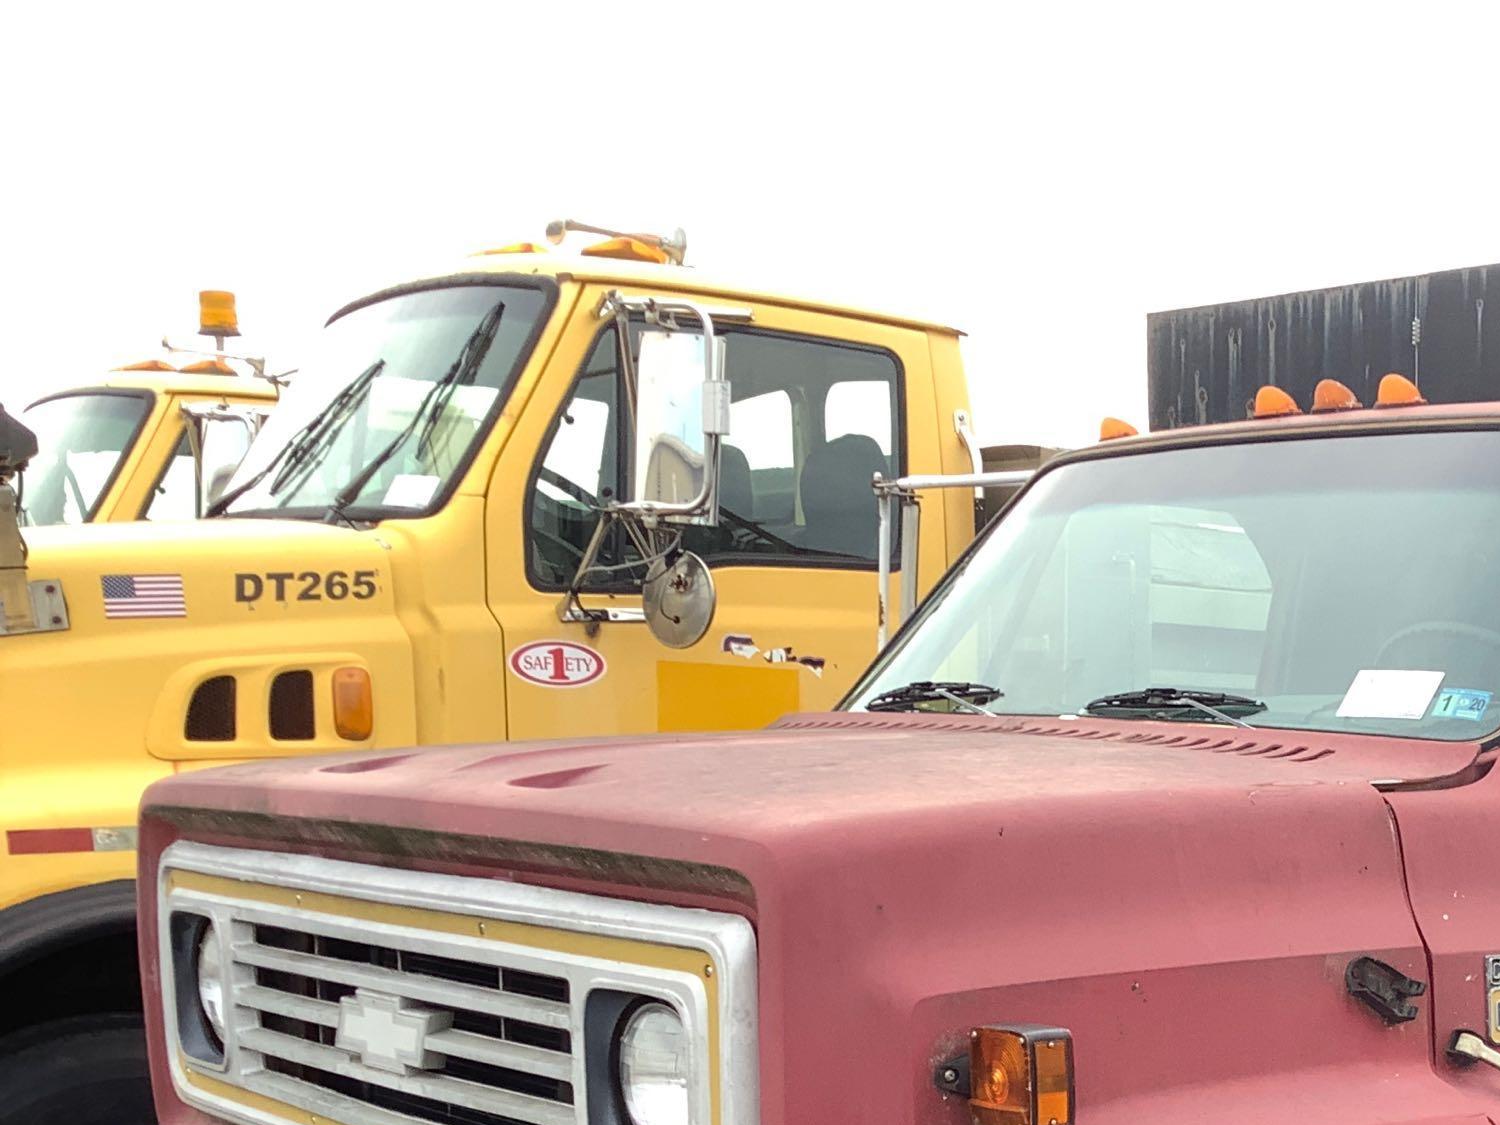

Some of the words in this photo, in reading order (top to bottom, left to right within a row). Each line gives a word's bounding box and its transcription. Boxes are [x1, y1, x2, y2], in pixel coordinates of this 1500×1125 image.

[234, 570, 376, 603] DT265
[1442, 694, 1453, 711] 1
[1468, 697, 1486, 711] 20
